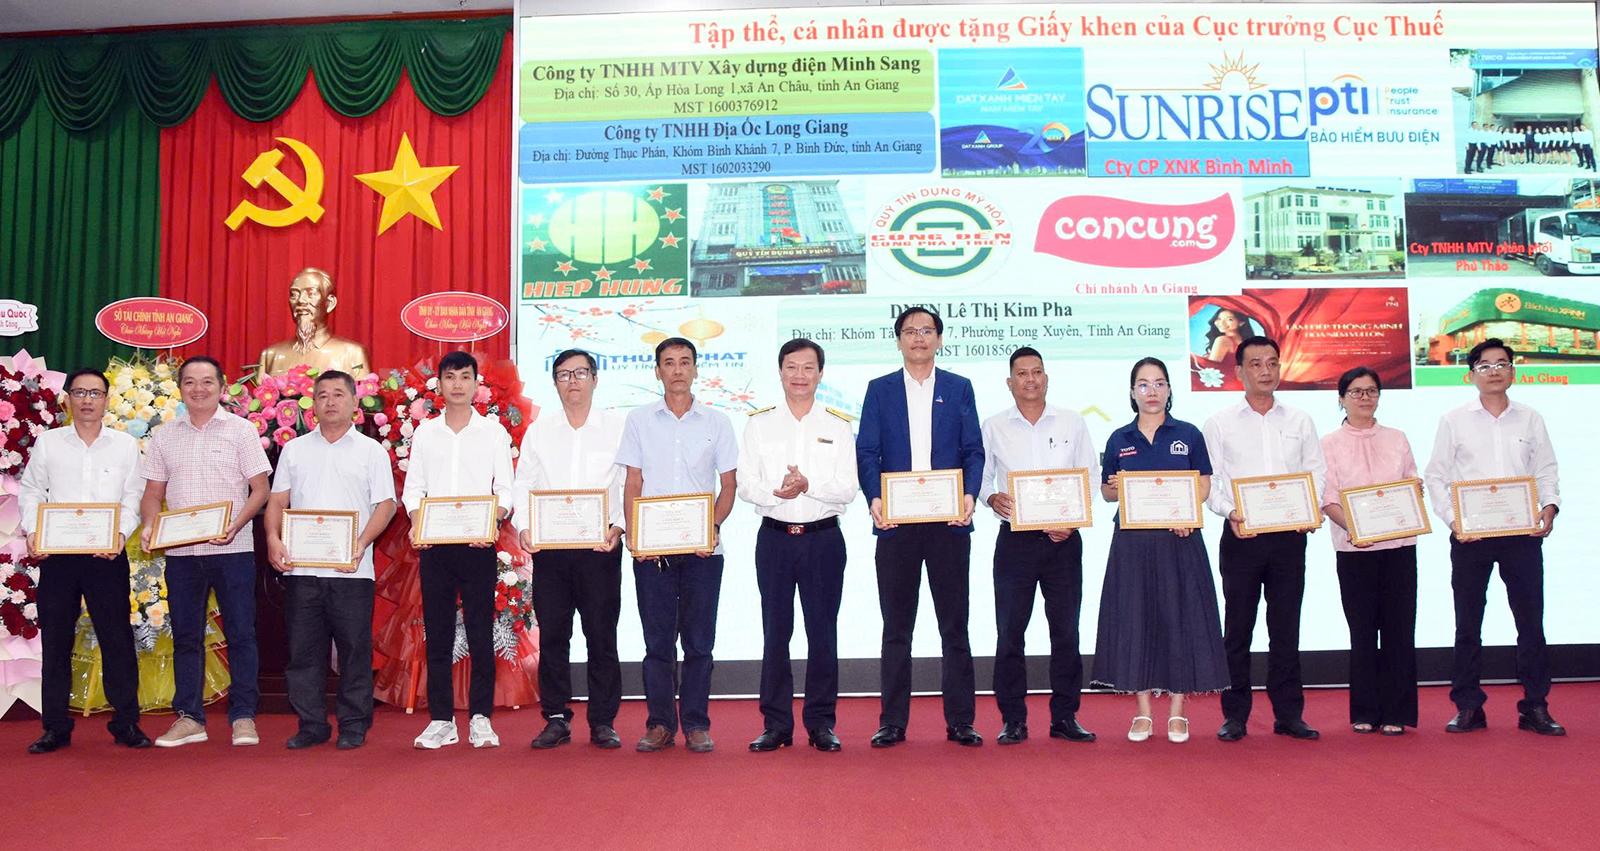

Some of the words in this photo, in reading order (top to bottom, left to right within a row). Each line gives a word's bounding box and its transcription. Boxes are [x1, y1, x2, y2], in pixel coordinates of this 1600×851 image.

[689, 21, 735, 48] Tập
[744, 15, 786, 45] thể,
[793, 20, 818, 40] cá
[827, 19, 884, 39] nhân
[893, 19, 950, 43] được
[959, 18, 1010, 43] tặng
[1018, 10, 1072, 42] Giấy
[1081, 16, 1137, 36] khen
[1146, 15, 1184, 36] của
[1193, 15, 1239, 41] Cục
[1246, 15, 1326, 42] trưởng
[1333, 16, 1378, 41] Cục
[1385, 10, 1444, 36] Thuế
[533, 66, 575, 83] Công
[580, 66, 596, 82] ty
[600, 63, 654, 78] TNHH
[660, 61, 704, 76] MTV
[708, 60, 741, 78] Xây
[746, 60, 788, 77] dựng
[792, 58, 826, 76] điện
[832, 57, 875, 72] Minh
[880, 56, 921, 74] Sang
[554, 87, 575, 101] Địa
[605, 83, 620, 98] Số
[624, 85, 641, 98] 30,
[695, 84, 724, 97] Long
[758, 82, 775, 93] An
[779, 80, 812, 93] Châu,
[844, 80, 860, 91] An
[865, 79, 899, 92] Giang
[674, 102, 704, 113] MST
[709, 99, 778, 113] 1600376912
[1309, 83, 1369, 126] pti
[604, 125, 641, 142] Công
[645, 127, 658, 142] ty
[662, 123, 709, 138] TNHH
[714, 122, 737, 139] Địa
[742, 117, 761, 136] Ốc
[766, 121, 801, 138] Long
[806, 119, 848, 137] Giang
[1408, 129, 1440, 146] ĐIỆN
[533, 149, 550, 163] Địa
[576, 148, 609, 163] Đường
[614, 147, 638, 160] Thục
[673, 145, 703, 157] Khóm
[735, 143, 767, 155] Khánh
[824, 142, 848, 154] Đức,
[874, 141, 889, 152] An
[892, 140, 922, 154] Giang
[681, 163, 708, 175] MST
[712, 161, 771, 174] 1602033290
[1105, 160, 1132, 177] Cty
[1138, 159, 1159, 174] CP
[1164, 159, 1200, 174] XNK
[1206, 157, 1244, 174] Bình
[1250, 159, 1293, 174] Minh
[1055, 214, 1218, 250] concung
[1410, 242, 1429, 256] Cty
[1432, 242, 1464, 254] TNHH
[1468, 242, 1494, 254] MTV
[1101, 283, 1138, 294] nhánh
[1142, 283, 1158, 294] An
[1162, 282, 1198, 295] Giang
[166, 312, 175, 324] AN
[176, 313, 194, 324] GIANG
[947, 302, 967, 318] Lê
[971, 302, 998, 321] Thị
[1004, 302, 1038, 318] Kim
[1042, 302, 1073, 317] Pha
[841, 328, 875, 340] Khóm
[880, 327, 896, 339] Tâ
[962, 325, 1004, 340] Phường
[1010, 326, 1038, 340] Long
[1043, 324, 1082, 340] Xuyên,
[1117, 325, 1133, 336] An
[1138, 324, 1171, 339] Giang
[1538, 372, 1569, 385] Giang
